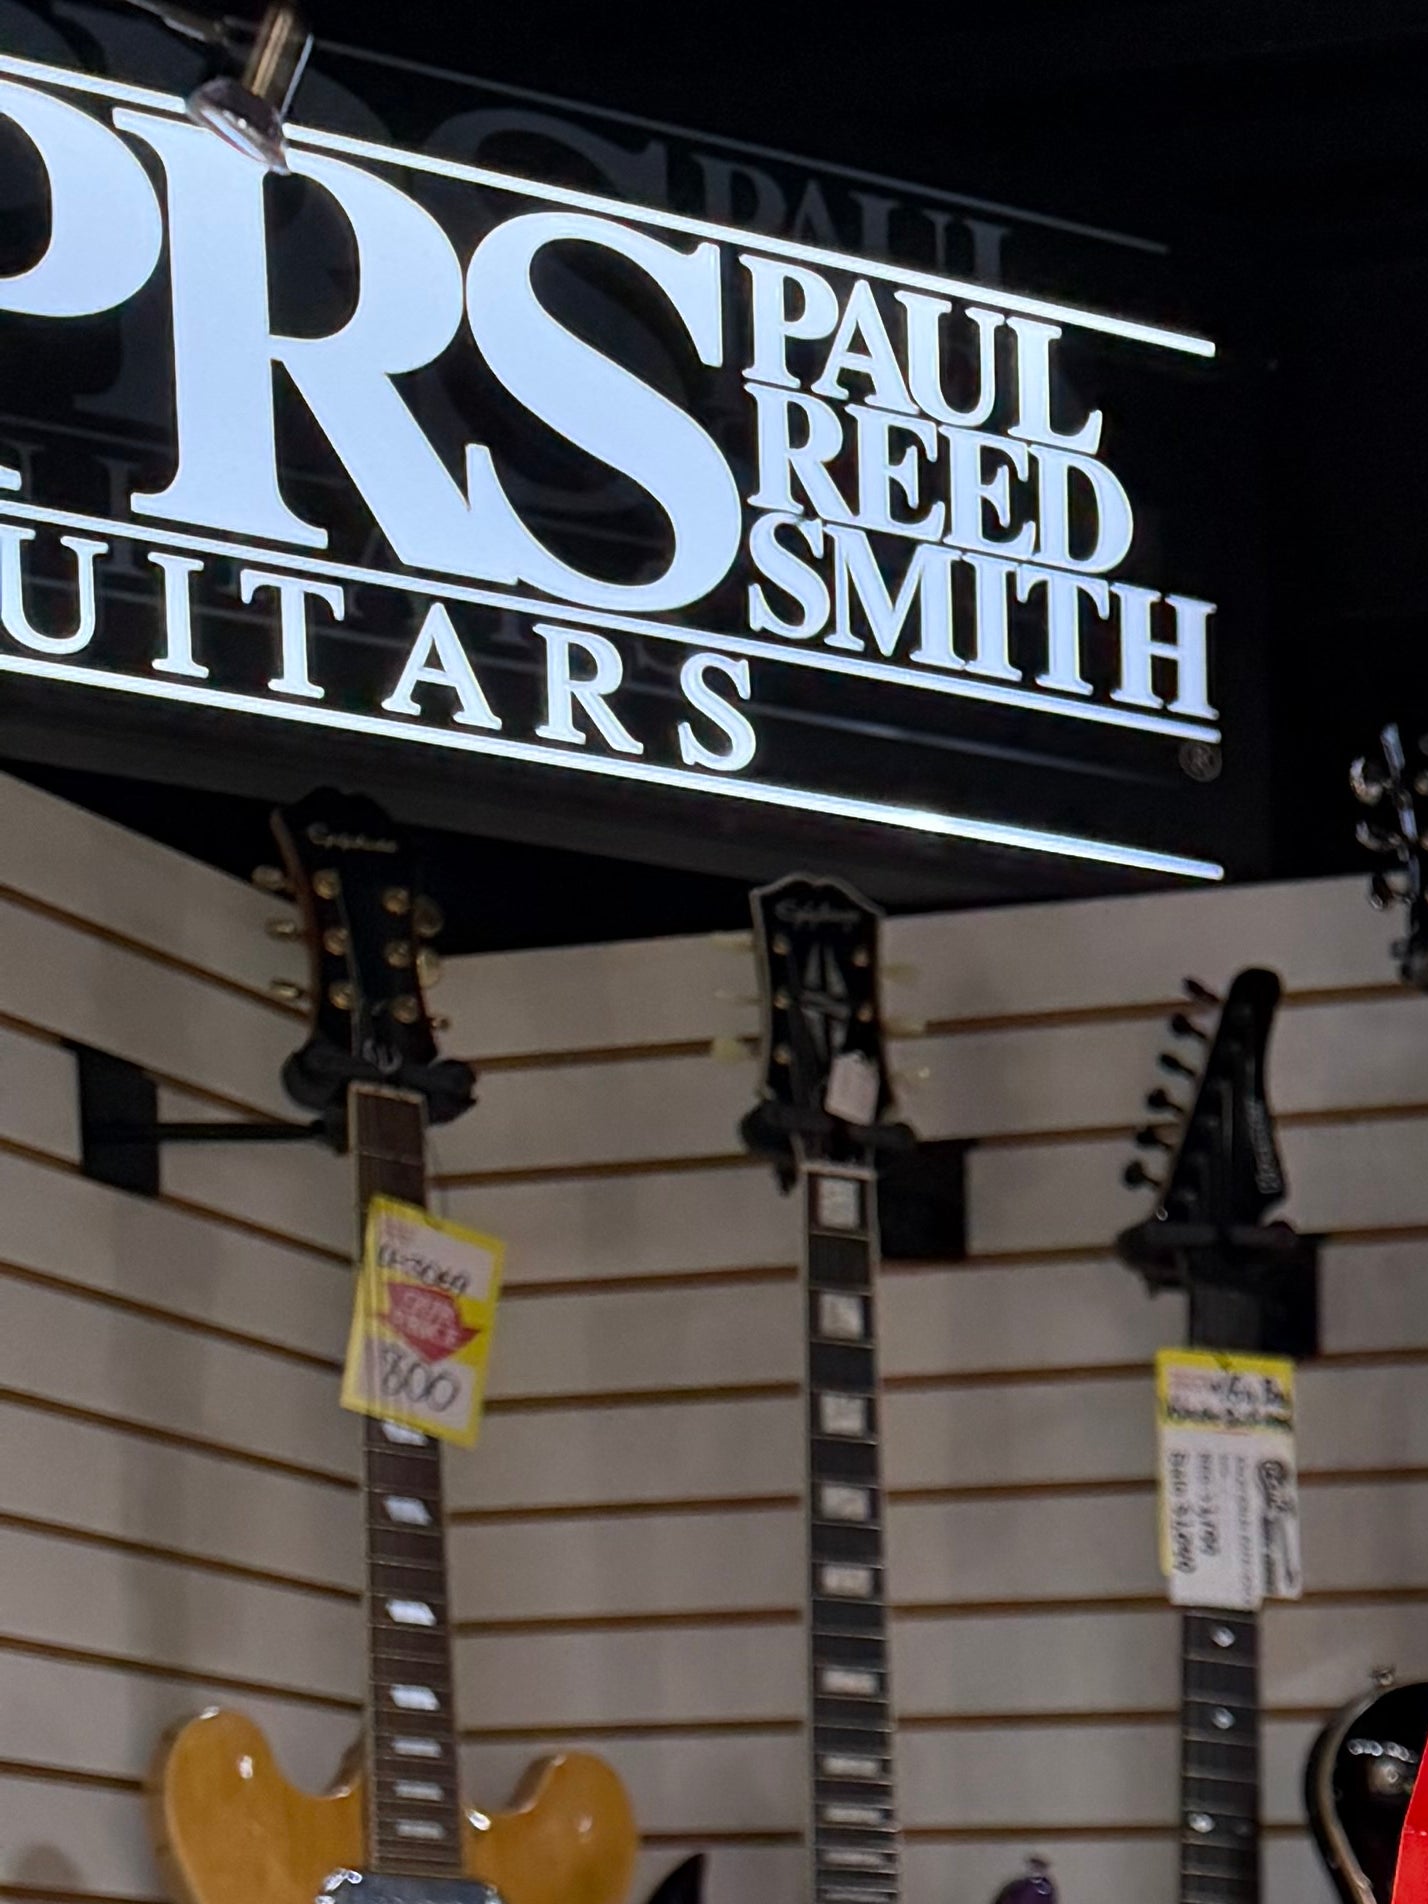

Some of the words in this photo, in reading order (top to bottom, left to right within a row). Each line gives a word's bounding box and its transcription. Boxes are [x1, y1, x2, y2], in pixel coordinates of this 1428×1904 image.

[741, 253, 1103, 455] PAUL
[746, 383, 1134, 574] REED
[0, 526, 758, 772] UITARS
[748, 513, 1218, 721] SMITH
